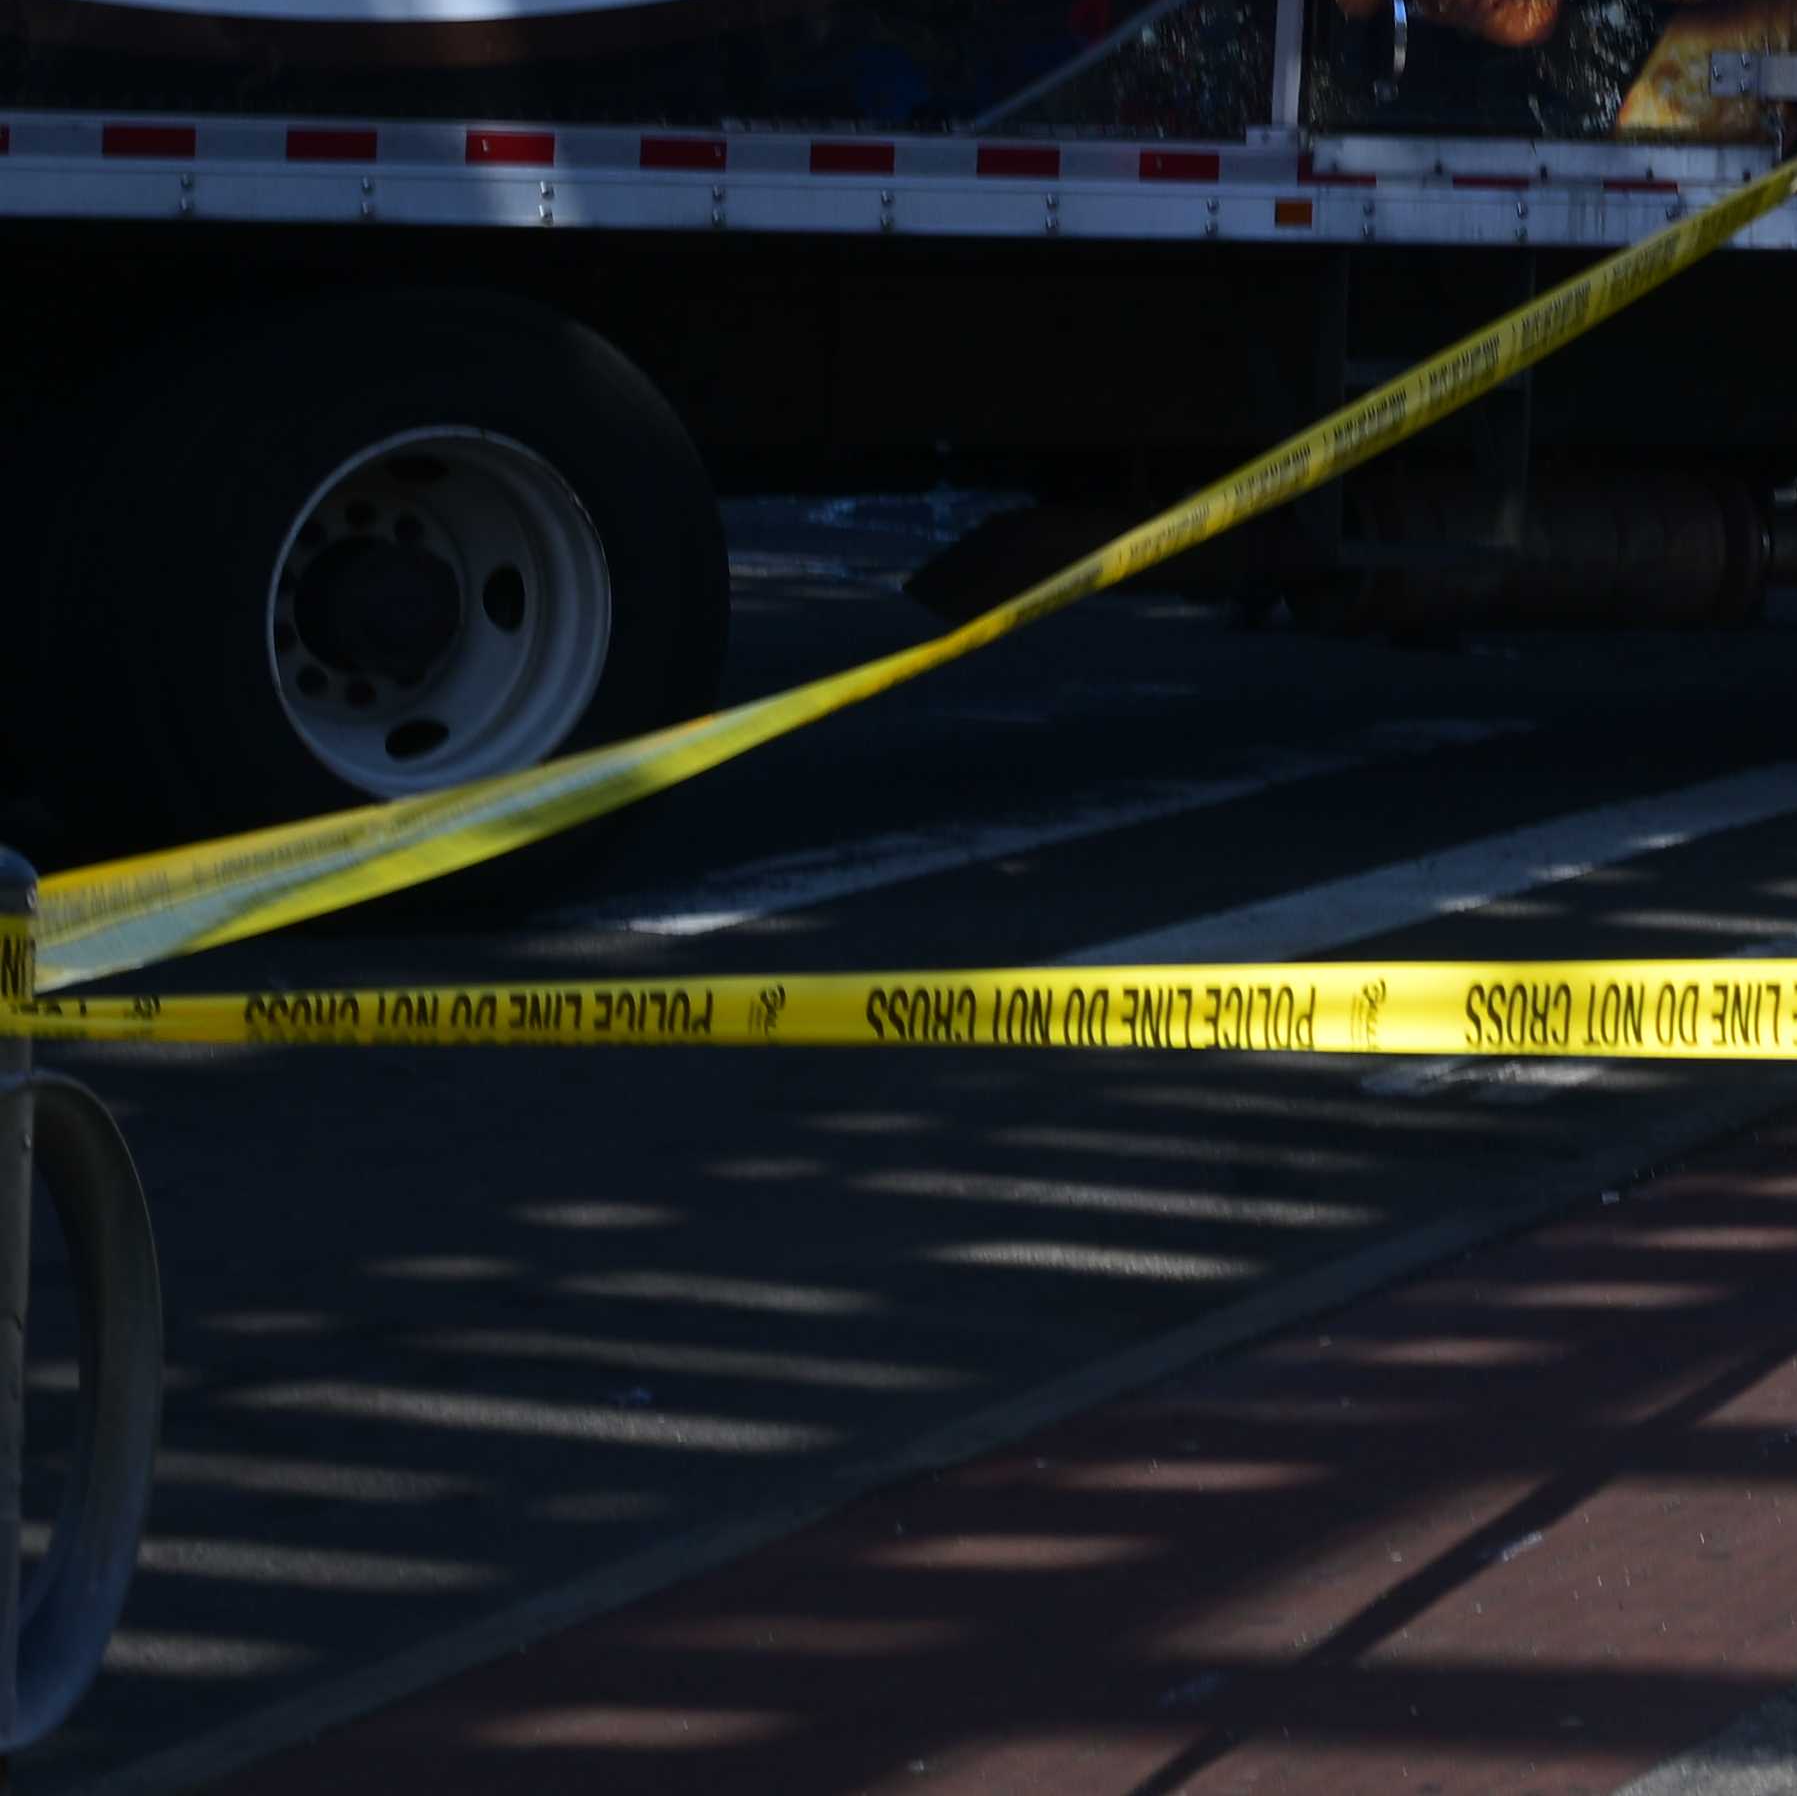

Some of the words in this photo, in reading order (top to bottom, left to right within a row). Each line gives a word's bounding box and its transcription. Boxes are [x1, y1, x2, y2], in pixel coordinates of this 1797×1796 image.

[508, 989, 584, 1030] LINE
[592, 987, 715, 1034] POLICE
[865, 986, 977, 1040] CROSS
[991, 987, 1054, 1044] NOT
[1062, 987, 1110, 1046] DO
[1120, 987, 1193, 1048] LINE
[1203, 986, 1316, 1051] POLICE
[1465, 982, 1573, 1047] CROSS
[1583, 983, 1645, 1046] NOT
[1655, 983, 1700, 1043] DO
[1711, 984, 1782, 1043] LINE
